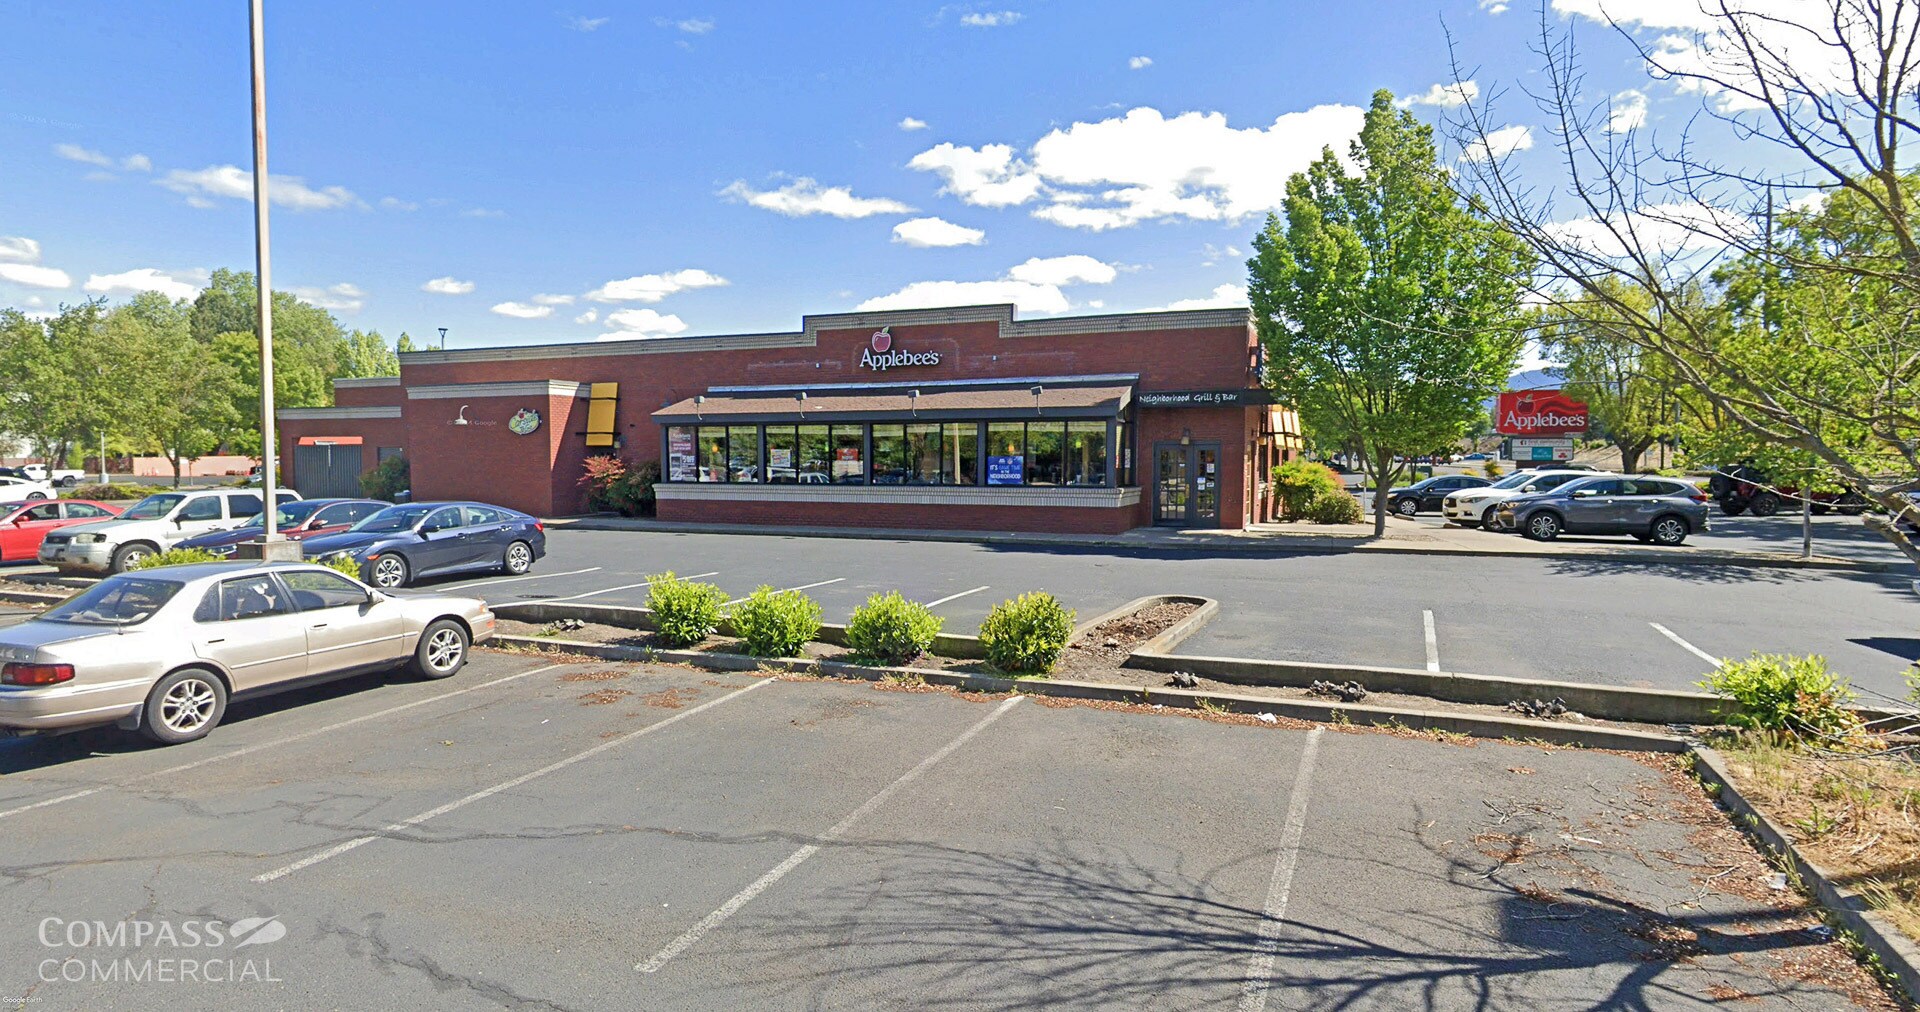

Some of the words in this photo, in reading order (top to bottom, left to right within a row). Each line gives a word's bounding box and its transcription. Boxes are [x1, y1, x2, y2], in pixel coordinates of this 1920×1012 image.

[859, 347, 940, 371] Applebee's
[1139, 393, 1191, 405] Neighborhood
[1193, 392, 1213, 403] Grill
[1215, 394, 1221, 404] &
[1222, 393, 1238, 402] Bar
[1503, 411, 1585, 430] Applebee's
